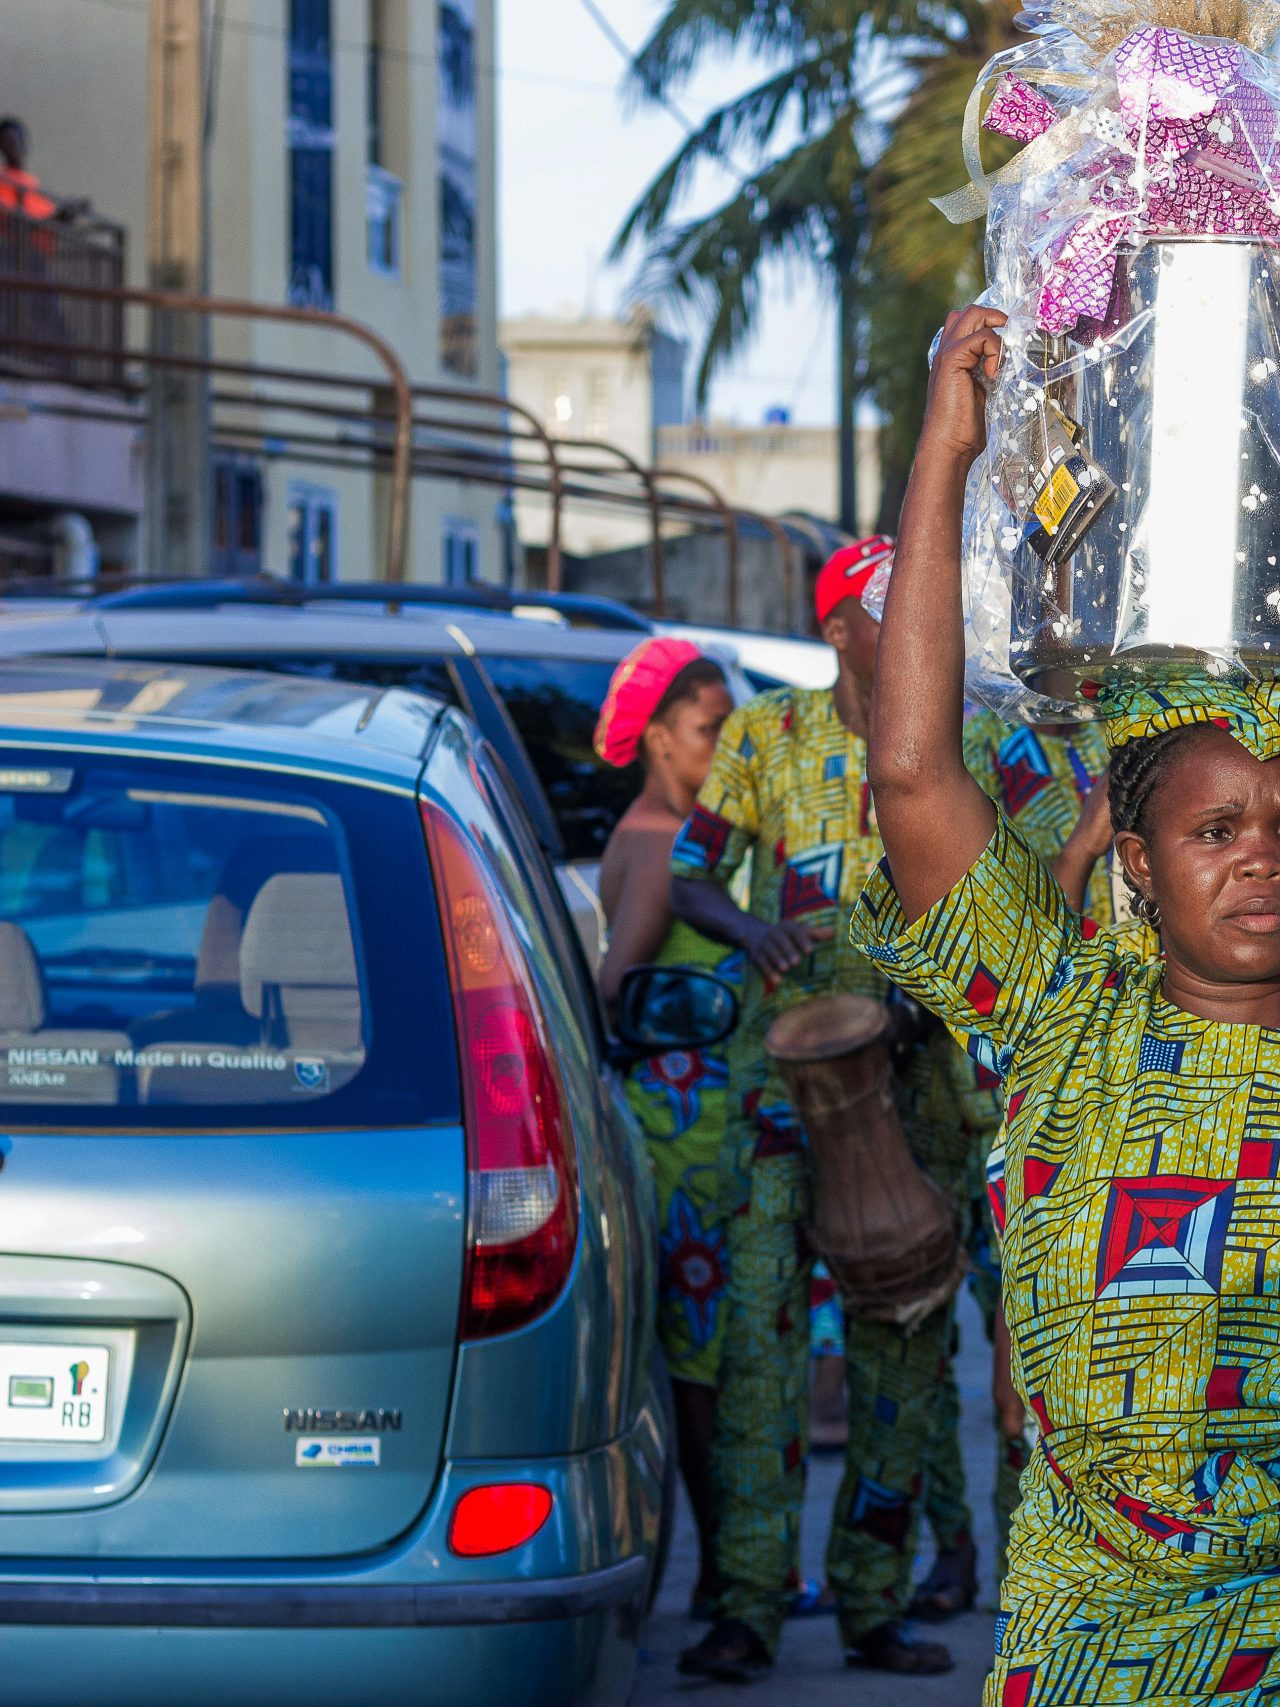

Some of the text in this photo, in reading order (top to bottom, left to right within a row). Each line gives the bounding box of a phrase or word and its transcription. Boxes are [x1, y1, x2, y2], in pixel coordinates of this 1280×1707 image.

[8, 1048, 287, 1071] NISSAN Made in Qualité
[61, 1400, 92, 1428] RB
[283, 1407, 403, 1432] NISSAN
